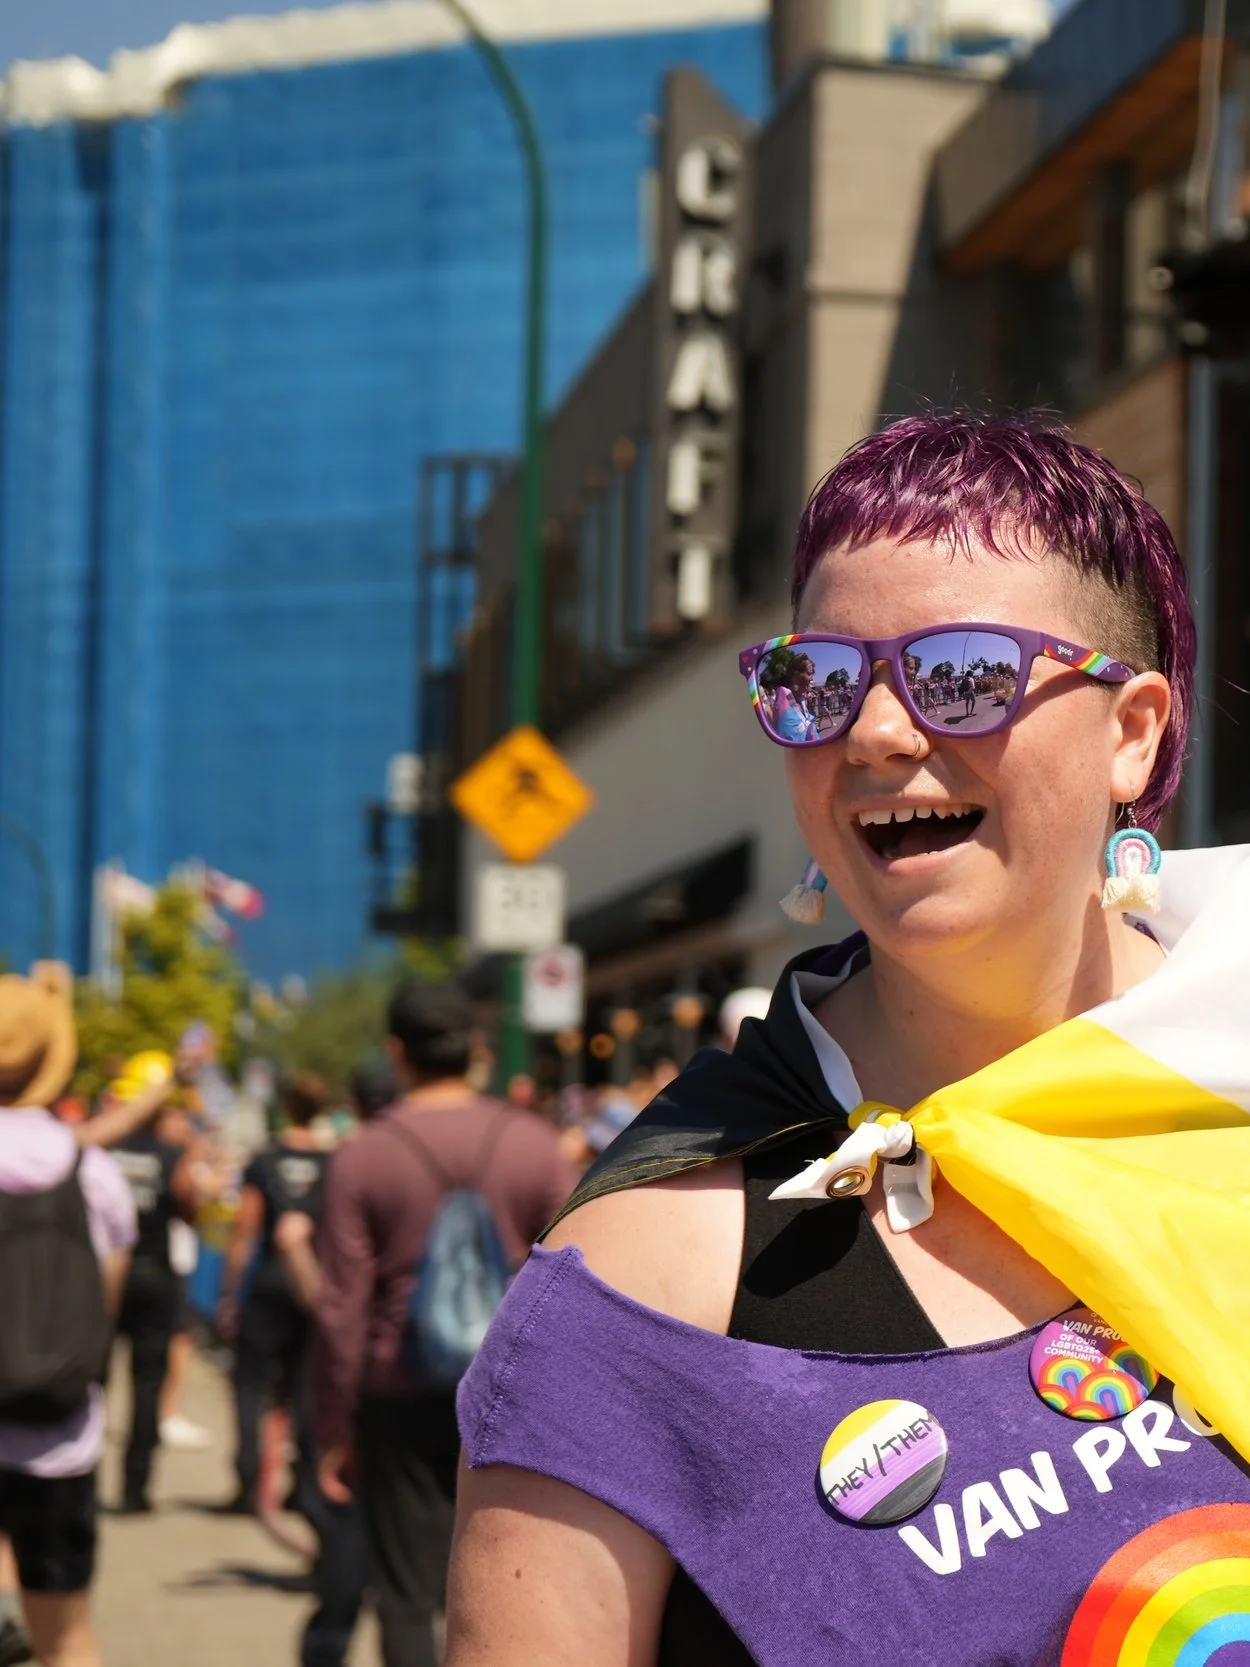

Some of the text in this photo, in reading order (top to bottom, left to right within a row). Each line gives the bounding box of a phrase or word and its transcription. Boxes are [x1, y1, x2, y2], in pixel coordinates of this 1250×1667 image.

[666, 137, 742, 620] CRAFT
[1060, 1333, 1097, 1346] OF OUR
[1063, 1319, 1127, 1342] VAN PRO
[1044, 1346, 1104, 1364] COMMUNITY
[1051, 1339, 1100, 1355] LGBTQ2S+
[898, 1451, 1069, 1575] VAN
